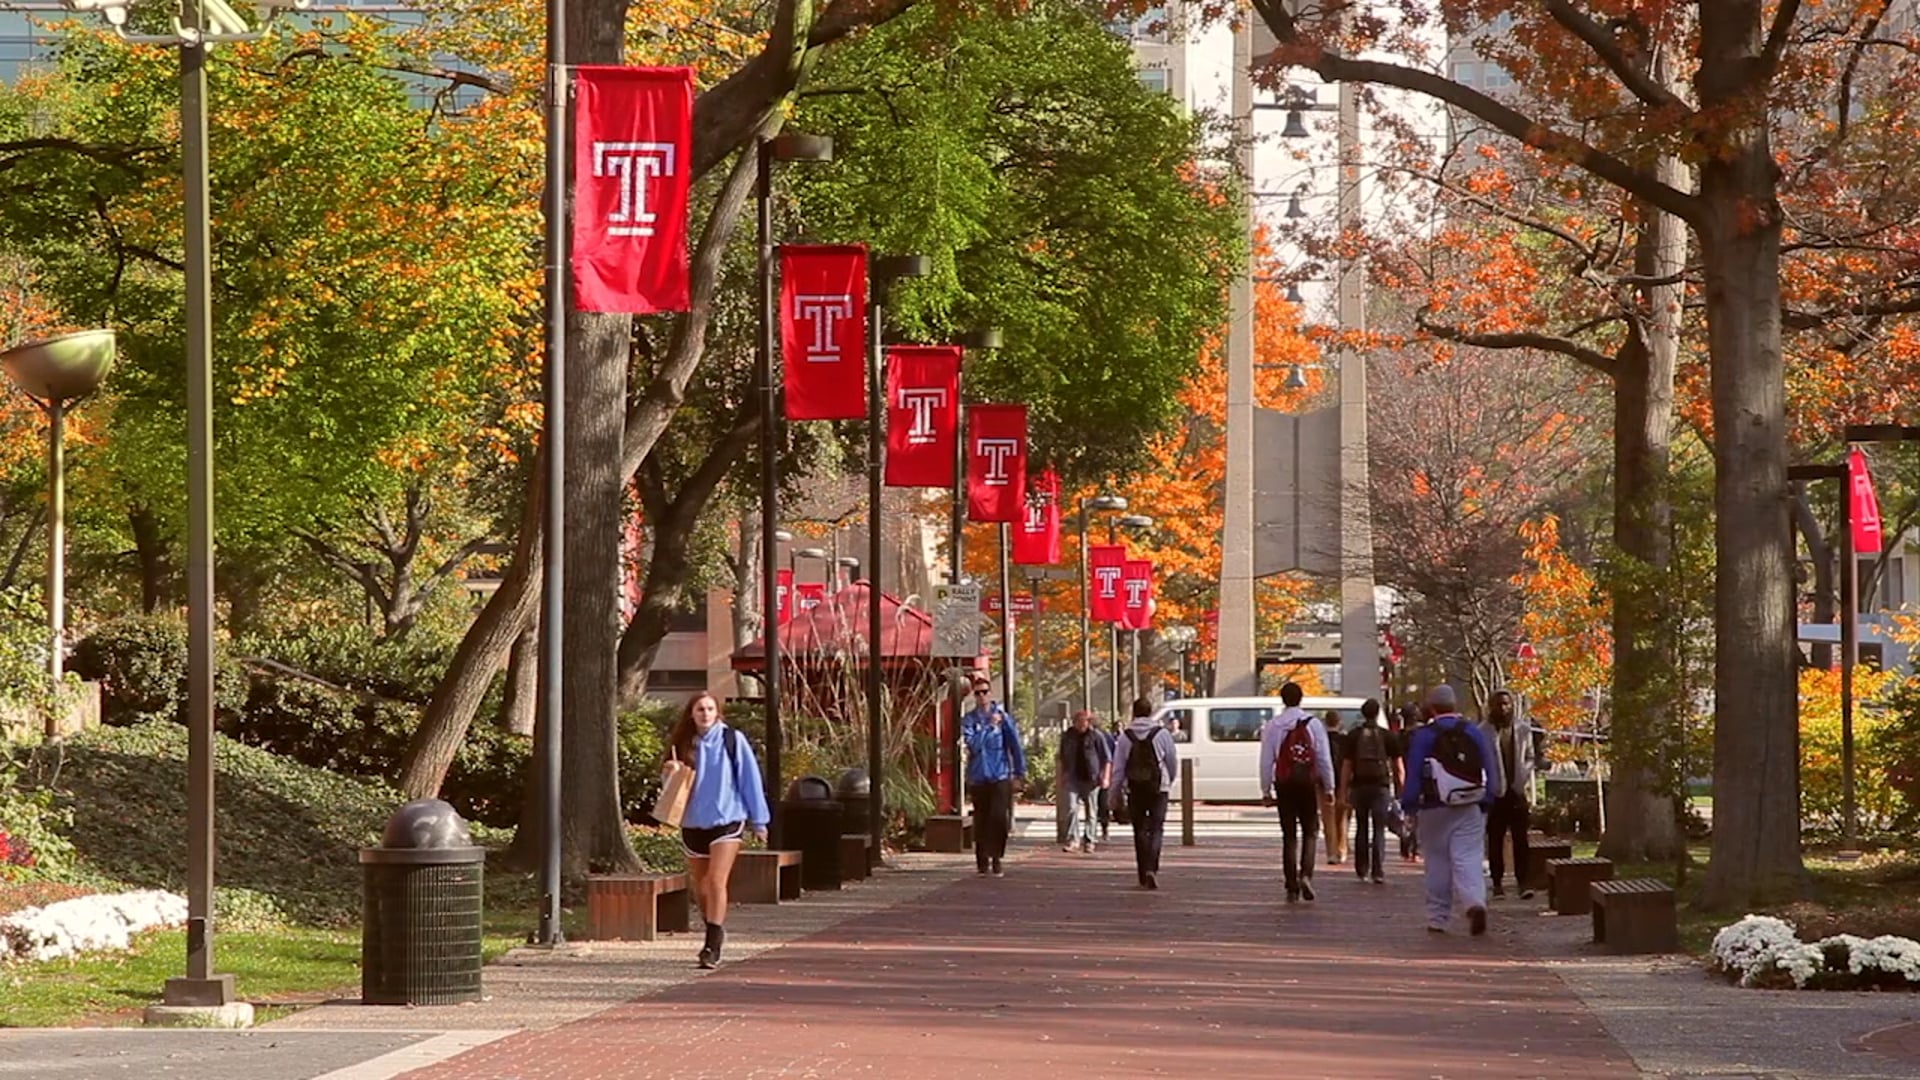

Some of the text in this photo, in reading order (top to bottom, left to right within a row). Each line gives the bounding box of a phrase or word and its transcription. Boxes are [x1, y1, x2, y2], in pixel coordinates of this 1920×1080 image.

[593, 141, 675, 236] T
[794, 294, 853, 362] T
[899, 388, 946, 443] T
[977, 439, 1017, 485] T
[1095, 567, 1121, 598] T
[1123, 579, 1147, 608] T
